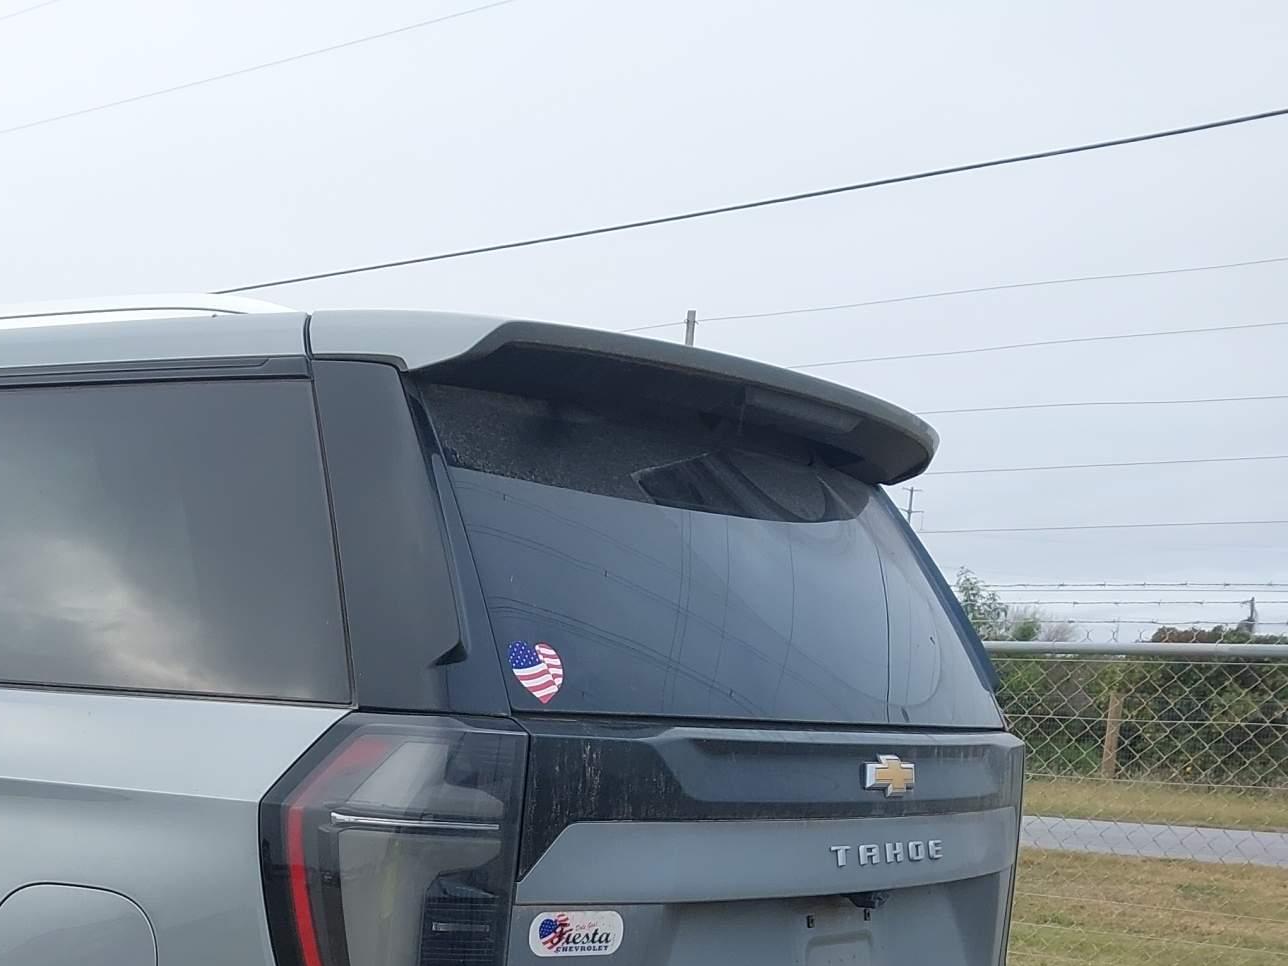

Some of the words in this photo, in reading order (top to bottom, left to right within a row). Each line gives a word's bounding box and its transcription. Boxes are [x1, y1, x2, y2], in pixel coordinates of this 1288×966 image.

[830, 839, 944, 867] TAHOE
[551, 926, 612, 946] Fiesta
[554, 945, 609, 953] CHEVROLET
